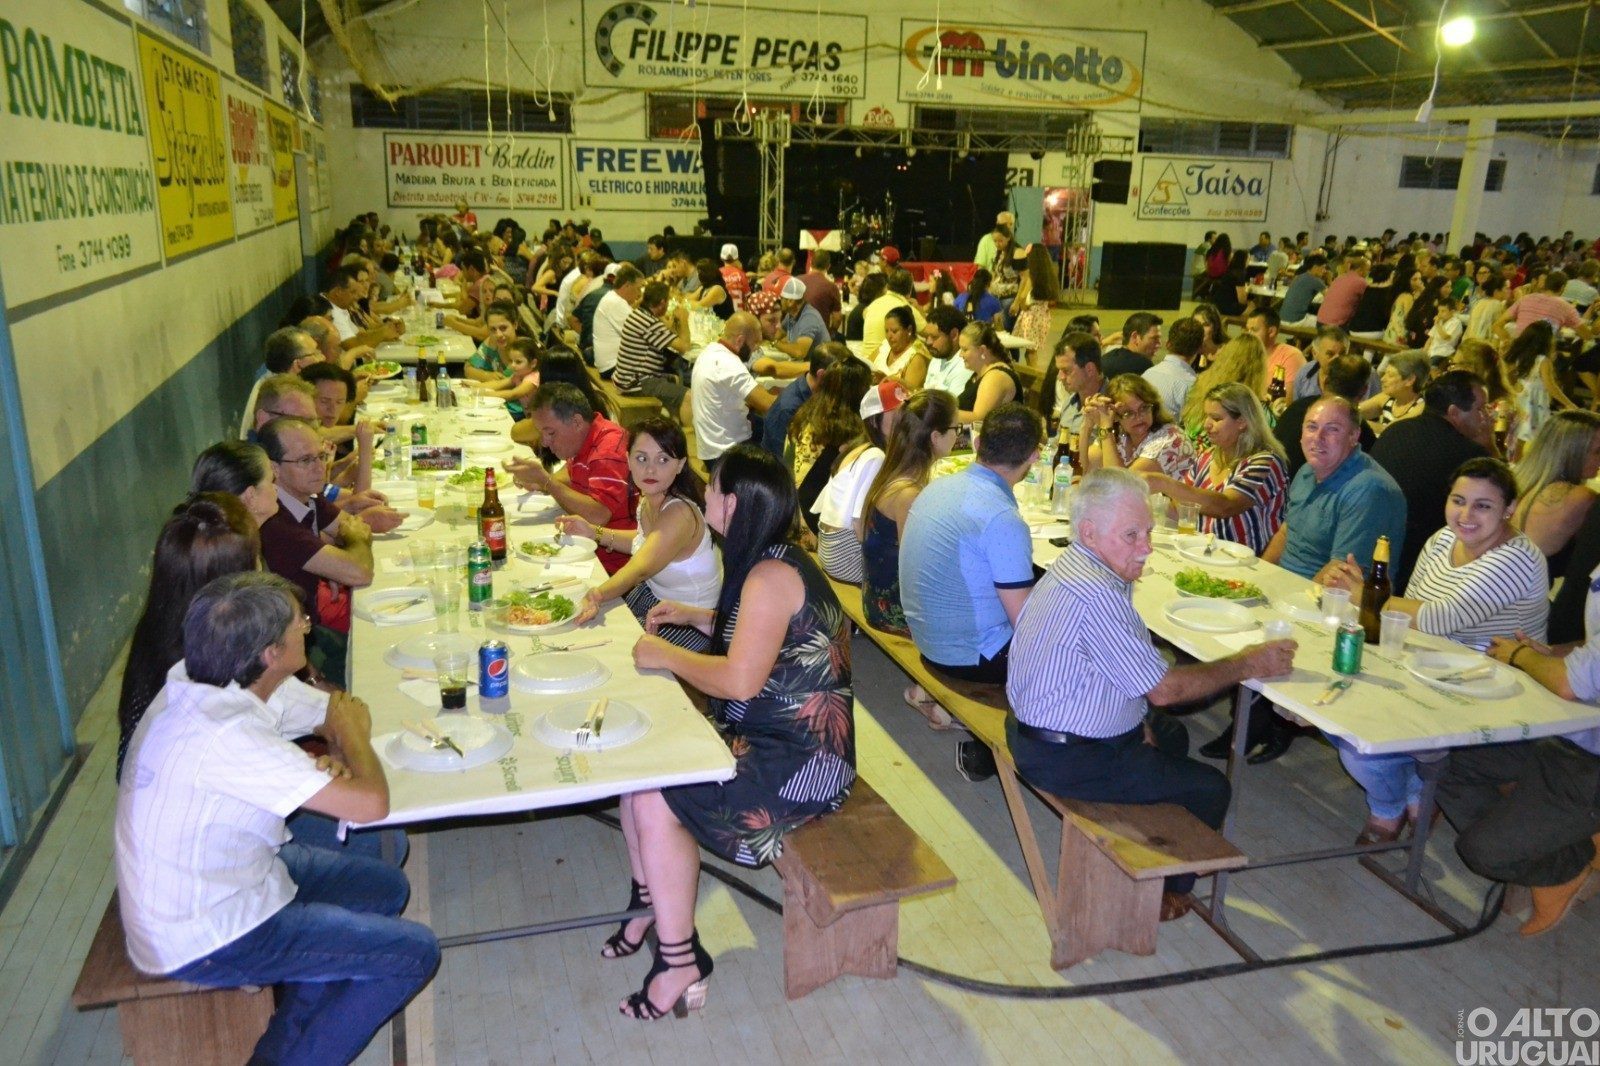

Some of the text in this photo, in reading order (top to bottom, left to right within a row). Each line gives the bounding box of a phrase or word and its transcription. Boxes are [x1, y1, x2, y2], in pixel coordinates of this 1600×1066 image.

[629, 28, 841, 72] FILIPPE PEÇAS
[996, 38, 1123, 85] binotto
[639, 64, 708, 78] ROLAMENTOS
[832, 75, 858, 85] 1640
[831, 86, 858, 95] 1900
[390, 142, 482, 168] PARQUET
[396, 173, 437, 186] MADEIRA
[442, 174, 476, 186] BRUTA
[492, 174, 557, 188] BENEFICIADA
[1185, 163, 1267, 196] Taisa
[1142, 205, 1191, 217] Confecções
